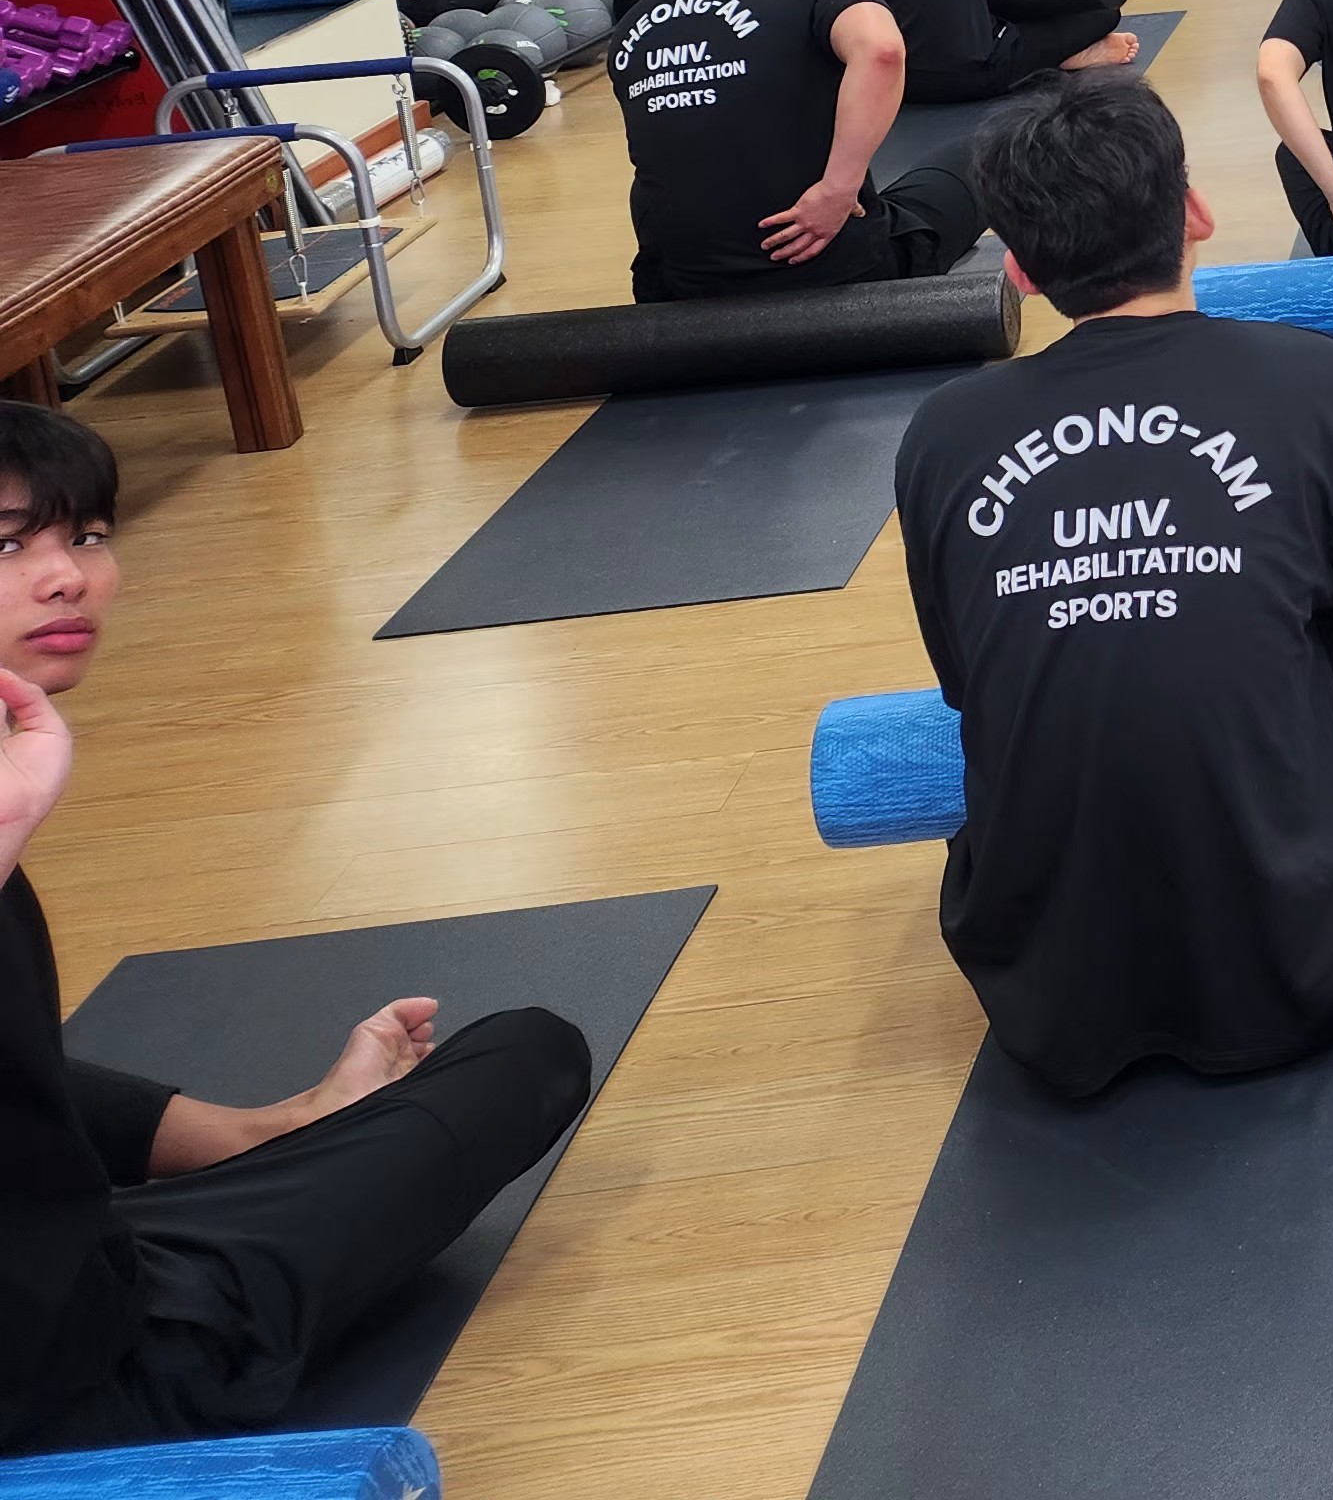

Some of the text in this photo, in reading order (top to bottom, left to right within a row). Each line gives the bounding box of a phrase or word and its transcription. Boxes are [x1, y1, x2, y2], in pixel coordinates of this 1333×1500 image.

[646, 41, 711, 70] UNIV.
[628, 59, 747, 99] REHABILITATION
[647, 88, 716, 113] SPORTS
[968, 404, 1273, 537] CHEONG-AM
[1054, 499, 1177, 547] UNIV.
[996, 546, 1242, 596] REHABILITATION
[1048, 589, 1178, 629] SPORTS
